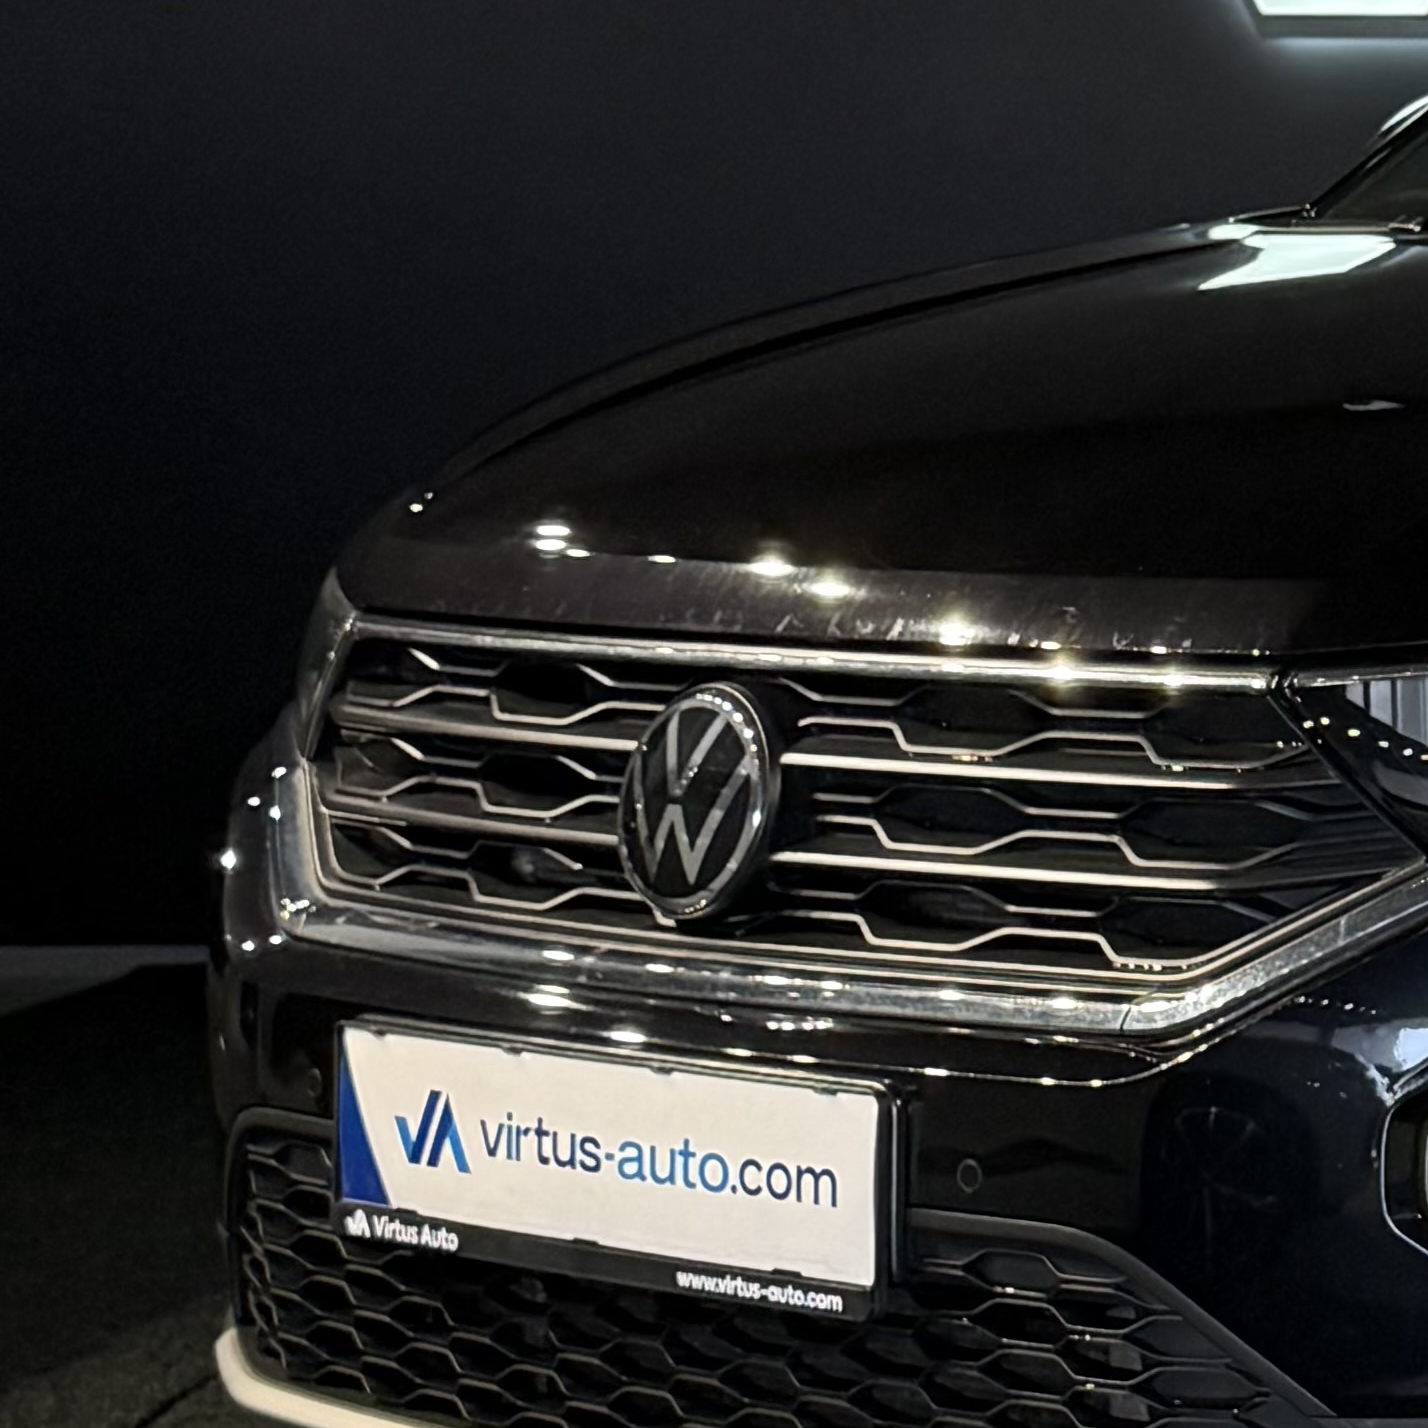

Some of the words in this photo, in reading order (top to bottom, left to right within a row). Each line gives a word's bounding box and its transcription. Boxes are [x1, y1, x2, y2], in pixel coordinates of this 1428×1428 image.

[480, 1112, 839, 1209] virtus-auto.com
[372, 1214, 419, 1245] Virtus
[420, 1223, 459, 1253] Auto
[675, 1270, 844, 1313] www.virtus-auto.com
